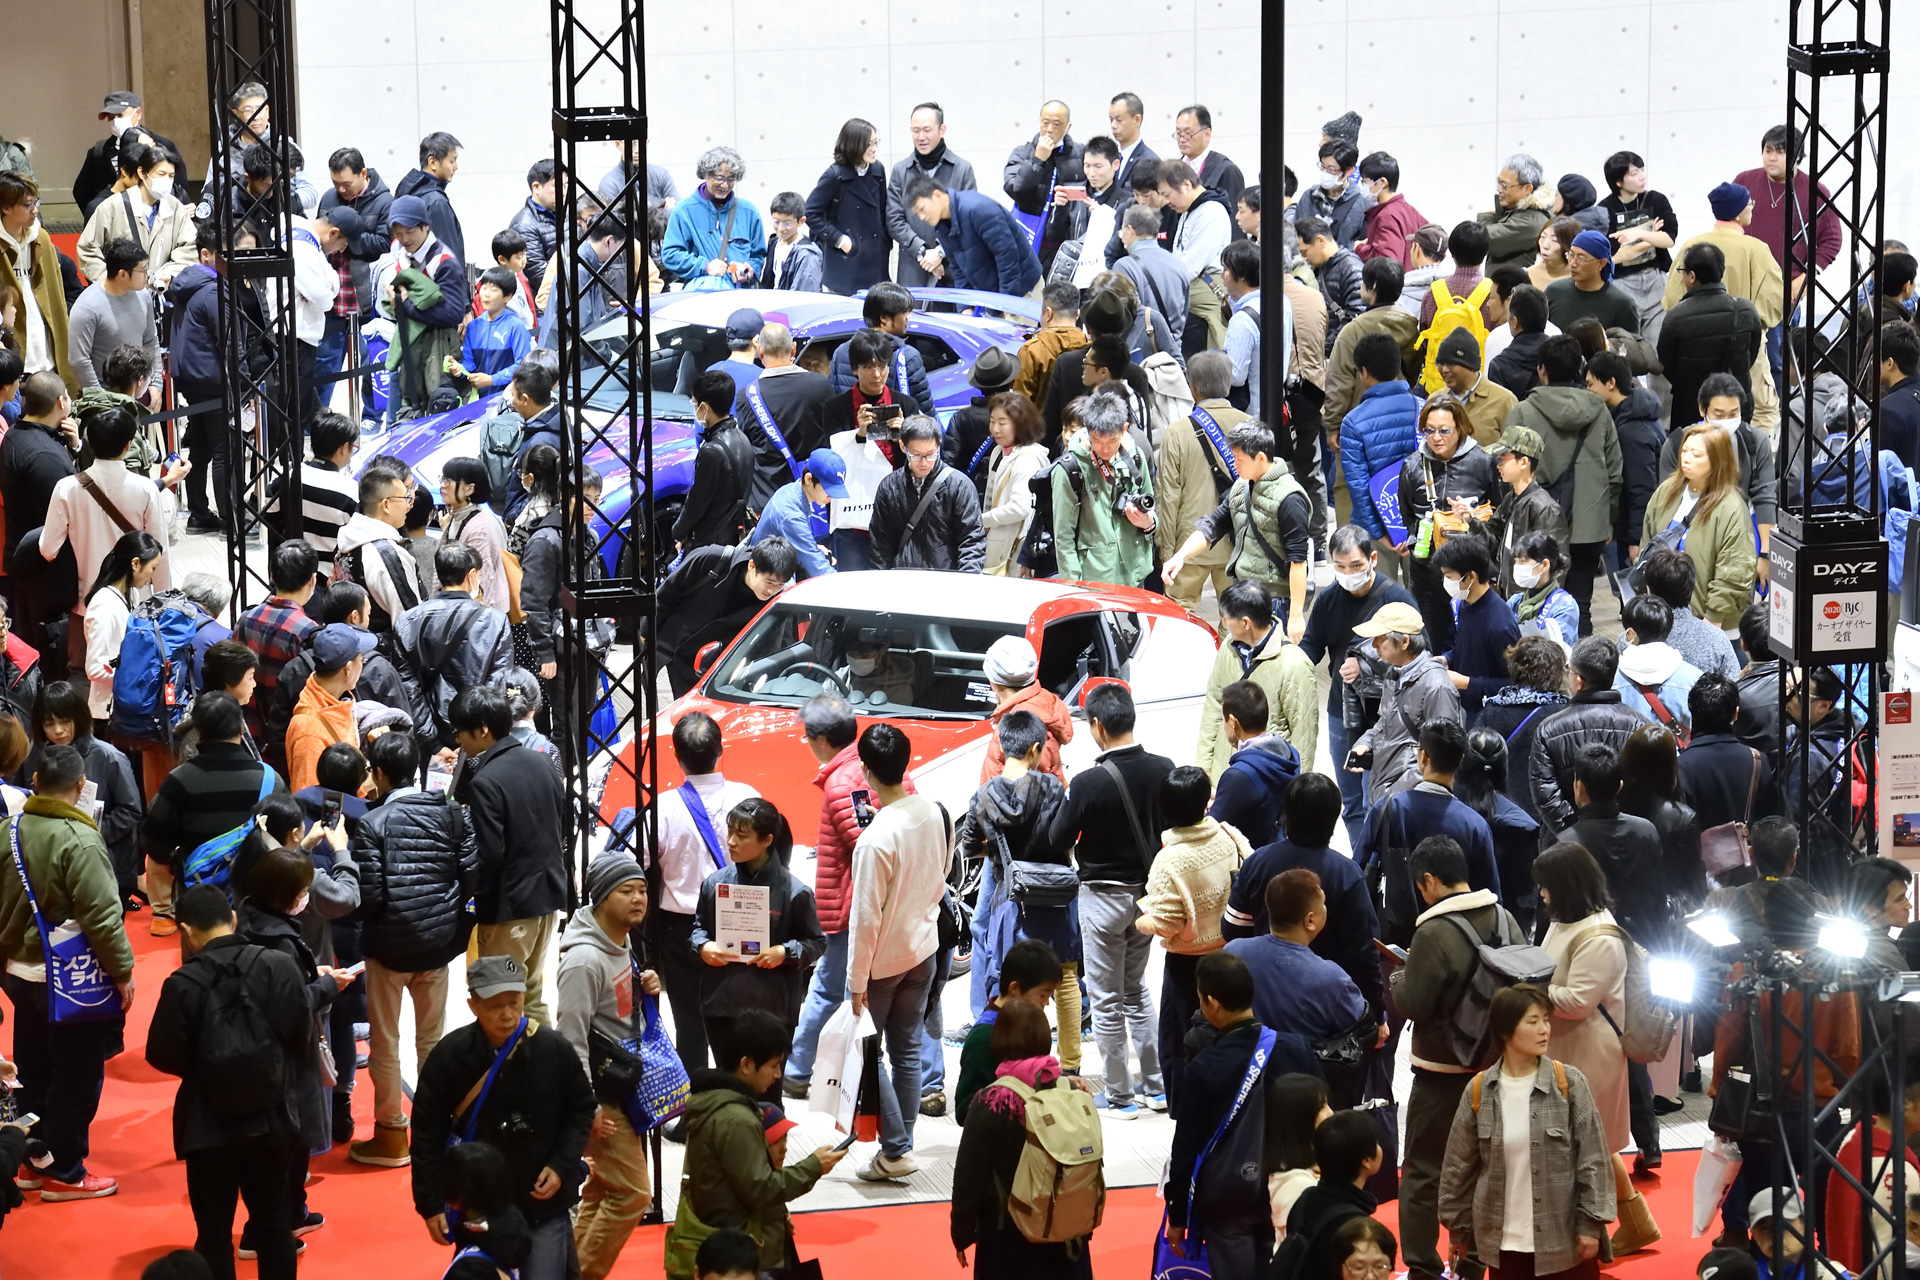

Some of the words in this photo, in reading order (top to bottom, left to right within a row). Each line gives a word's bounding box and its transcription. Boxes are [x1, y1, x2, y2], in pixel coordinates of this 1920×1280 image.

[751, 395, 770, 424] SPHERE
[764, 422, 781, 442] LIGHT
[1196, 412, 1222, 442] LIGHT
[843, 504, 875, 512] nism
[1771, 550, 1793, 573] DAYZ
[1813, 561, 1877, 576] DAYZ
[1834, 576, 1858, 585] デイズ
[1824, 606, 1841, 614] 2020
[1833, 631, 1851, 642] 受賞
[71, 968, 107, 986] ライト
[1237, 1065, 1261, 1105] SPHERE
